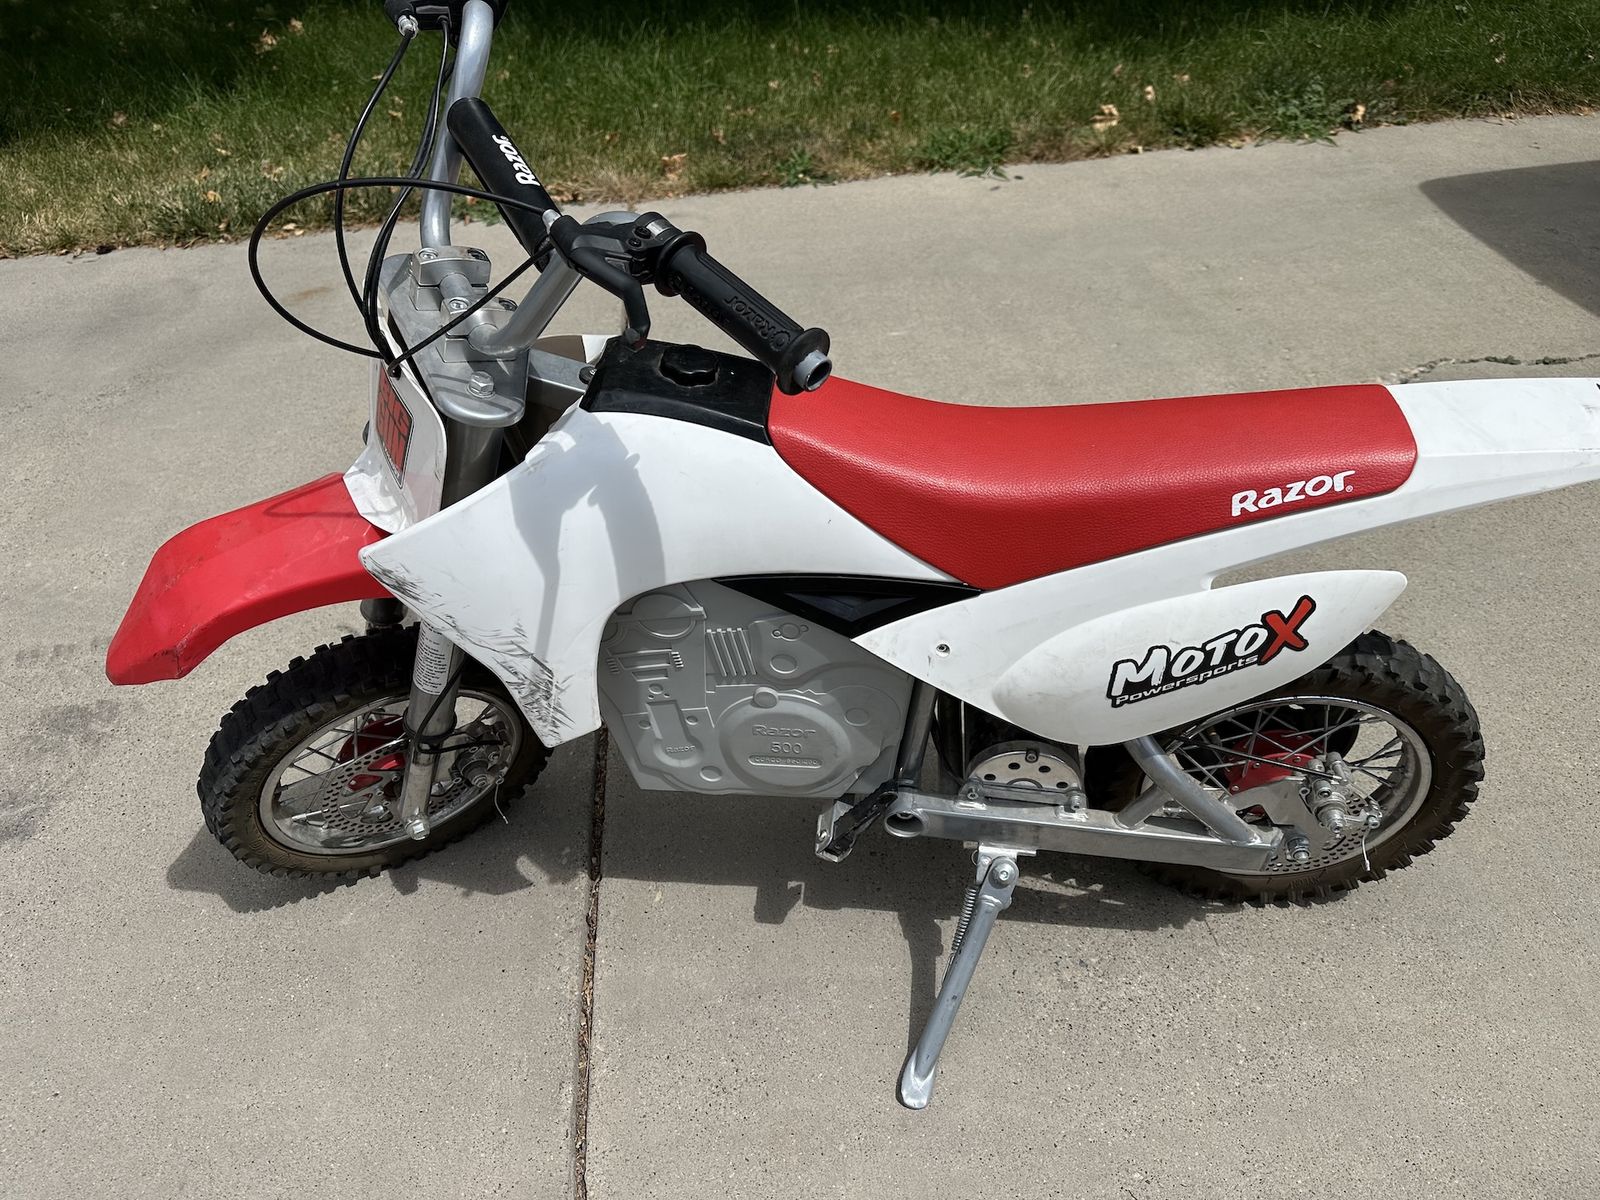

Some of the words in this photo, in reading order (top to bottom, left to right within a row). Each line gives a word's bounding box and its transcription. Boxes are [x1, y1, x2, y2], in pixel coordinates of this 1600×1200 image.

[492, 134, 541, 186] Razor
[1231, 470, 1356, 517] Razor
[1112, 654, 1259, 706] Powersports
[752, 724, 816, 738] Razor
[771, 741, 802, 754] 500
